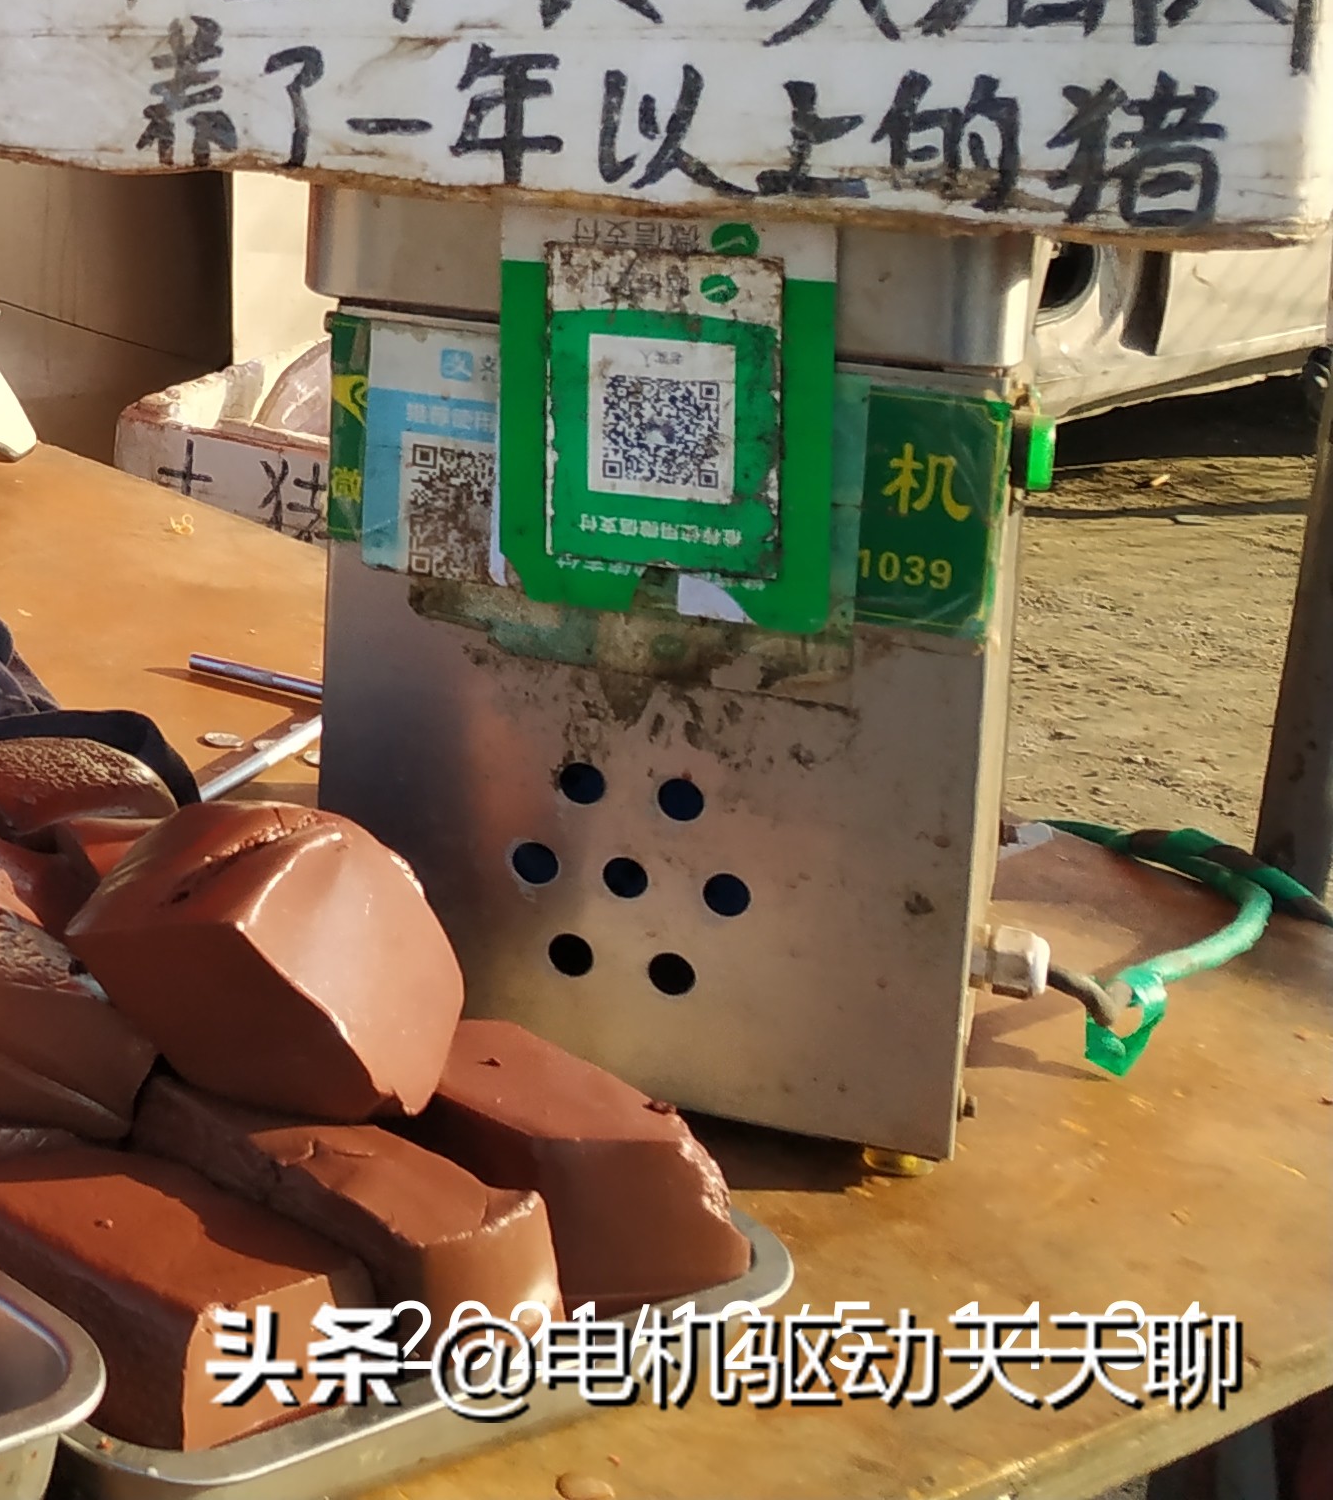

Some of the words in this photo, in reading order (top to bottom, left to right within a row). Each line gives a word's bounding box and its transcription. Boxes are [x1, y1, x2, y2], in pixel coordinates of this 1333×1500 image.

[136, 16, 1226, 227] 养了一年以上的猪
[572, 218, 701, 252] 微信支付
[882, 442, 973, 522] 机
